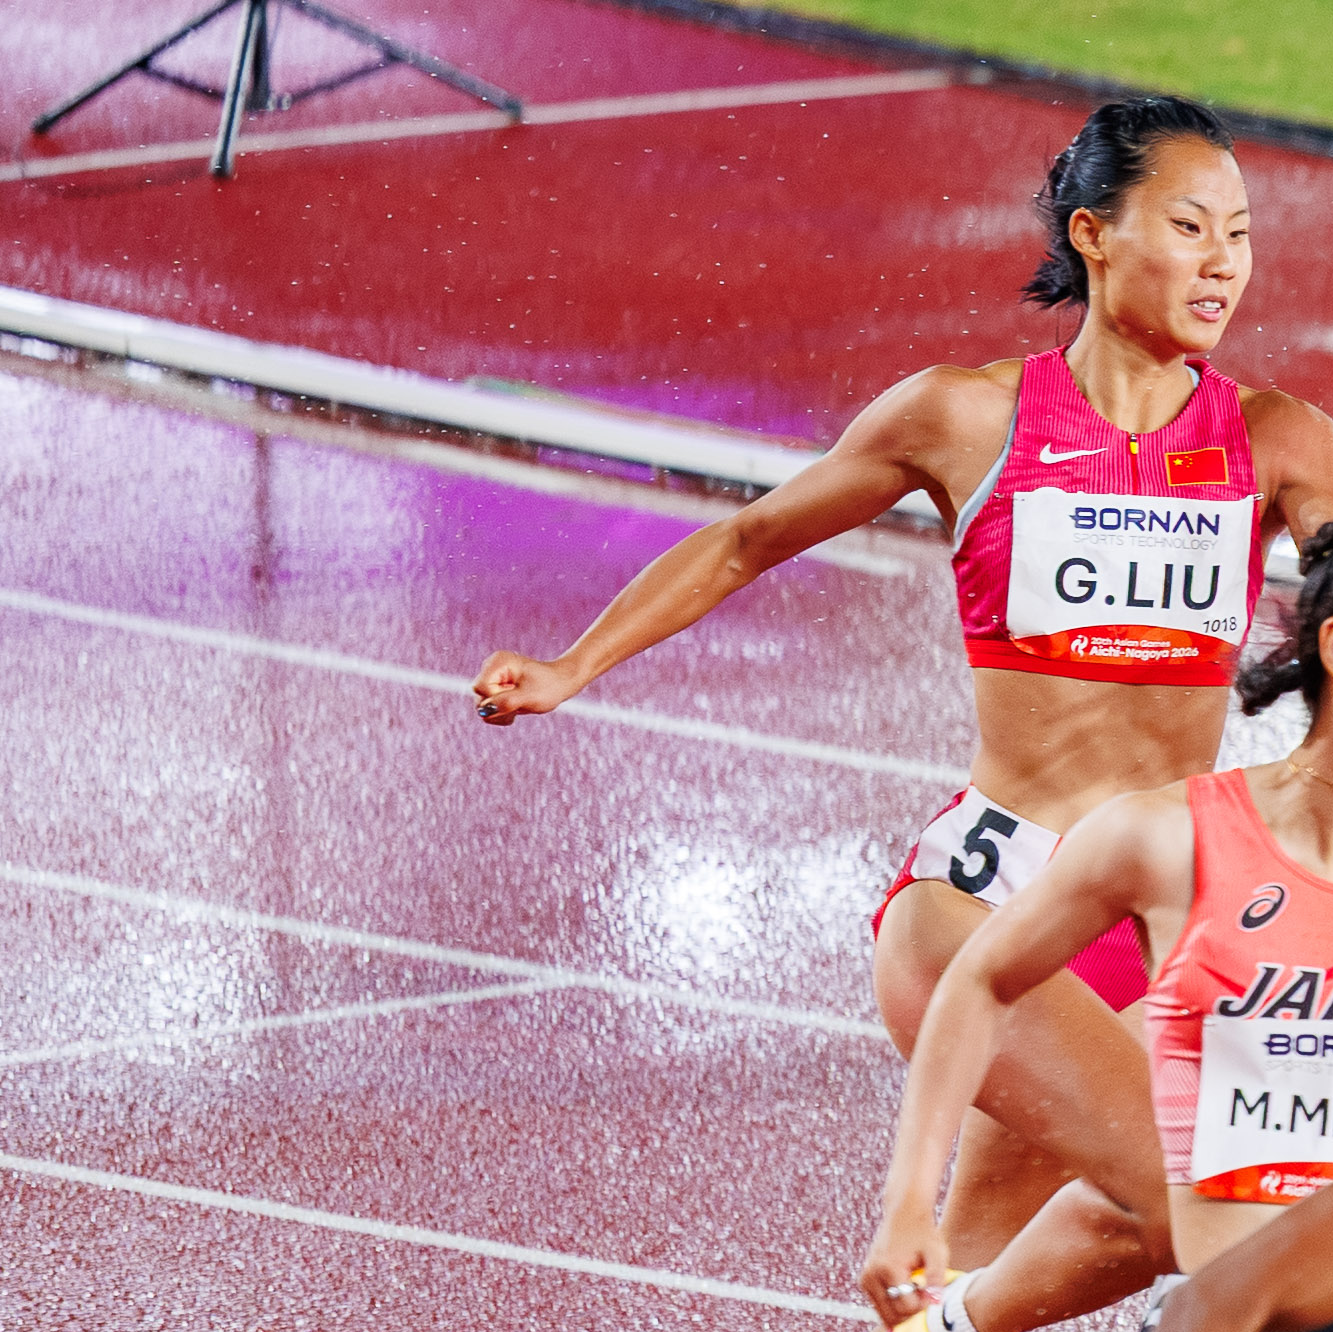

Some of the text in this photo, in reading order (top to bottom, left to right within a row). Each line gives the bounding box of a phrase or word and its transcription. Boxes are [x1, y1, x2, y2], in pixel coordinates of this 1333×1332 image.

[1068, 507, 1220, 536] BORNAN
[1073, 533, 1218, 551] SPORTS TECHNOLOGY
[1055, 556, 1221, 612] G.LIU
[1202, 616, 1238, 633] 1018
[1090, 637, 1171, 648] 20th Asian Games
[1089, 645, 1200, 661] Aichi-Nagoya 2026
[948, 807, 1020, 894] 5
